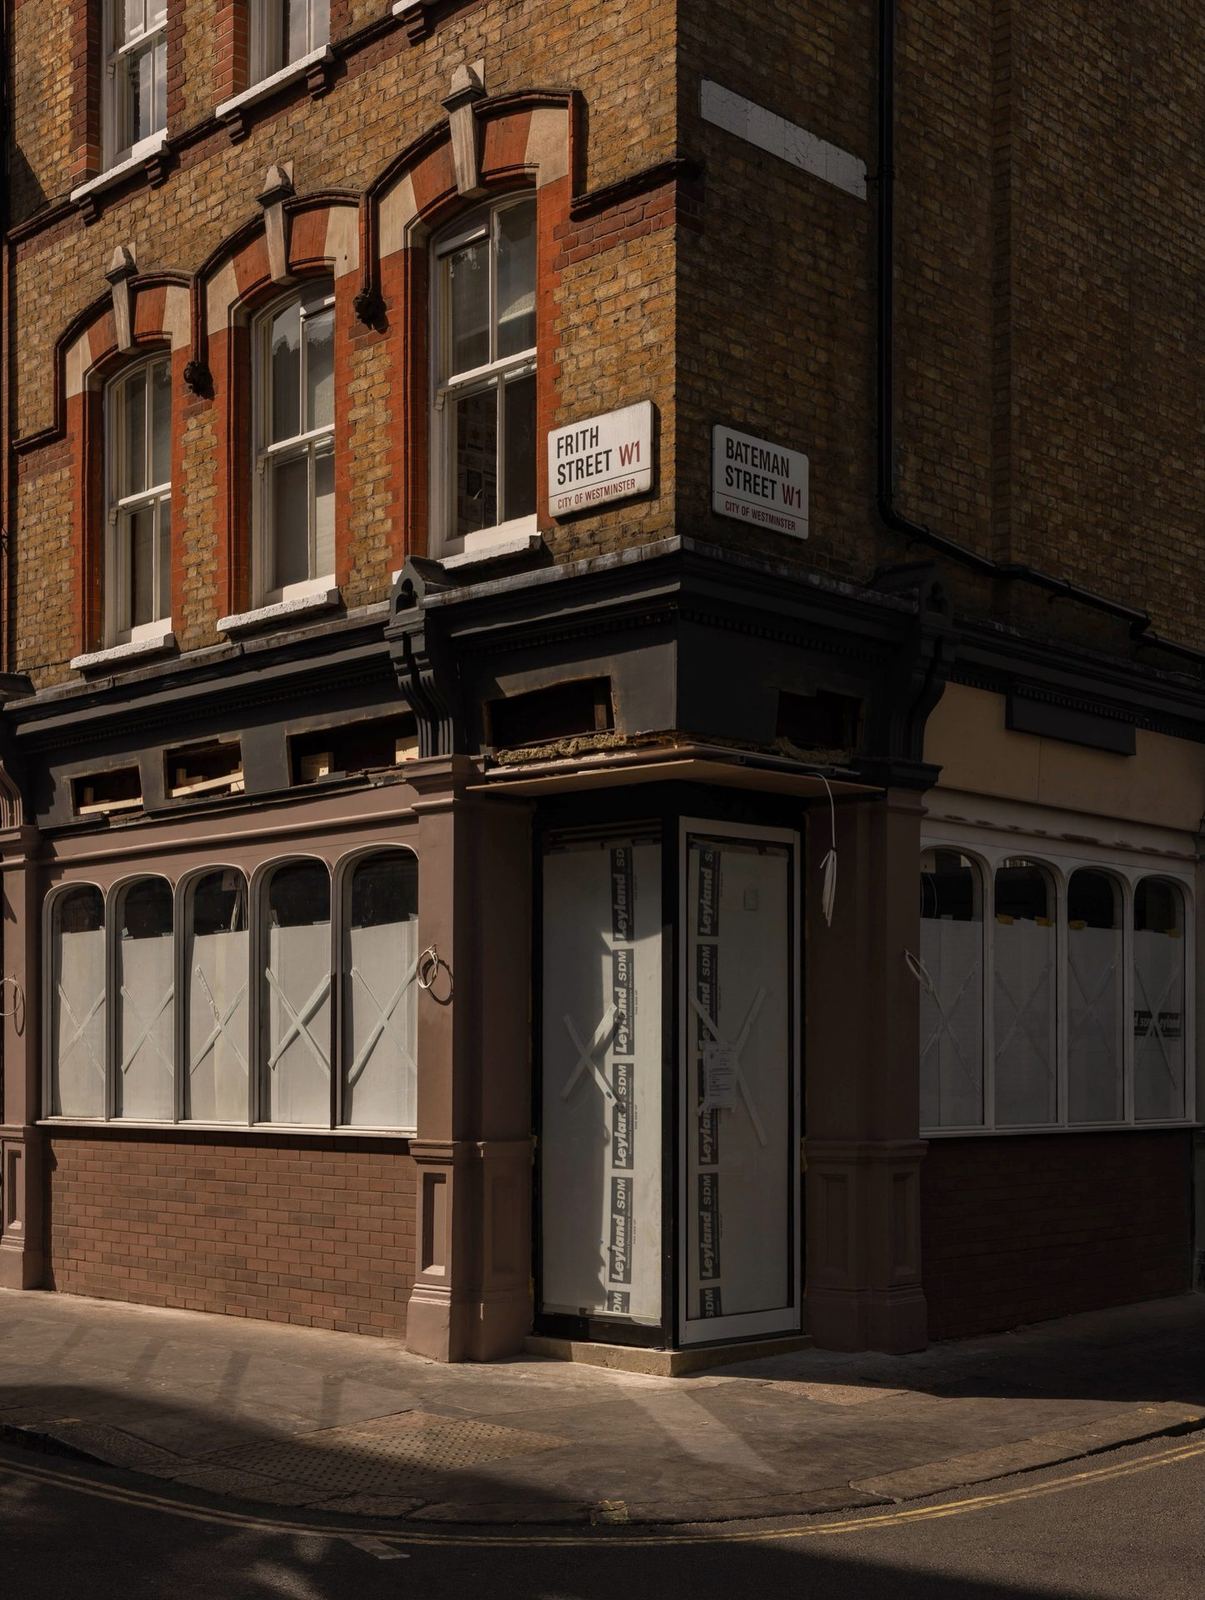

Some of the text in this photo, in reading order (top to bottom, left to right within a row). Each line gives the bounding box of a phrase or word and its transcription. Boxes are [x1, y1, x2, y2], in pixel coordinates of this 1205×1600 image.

[557, 425, 599, 459] FRITH
[557, 440, 640, 485] STREET W1
[725, 437, 790, 478] BATEMAN
[557, 478, 636, 509] CITY OF WESTMINSTER
[725, 465, 801, 509] STREET W1
[725, 500, 796, 531] CITY OF WESTMINSTER
[613, 873, 627, 939] Leyland
[700, 867, 713, 935] Leyland
[702, 946, 711, 976] SDM
[614, 951, 629, 1054] Leyand SDM
[614, 1064, 628, 1167] Leylan SDM
[611, 1178, 626, 1281] Leyland SDM
[700, 1175, 714, 1277] Leyland SDM
